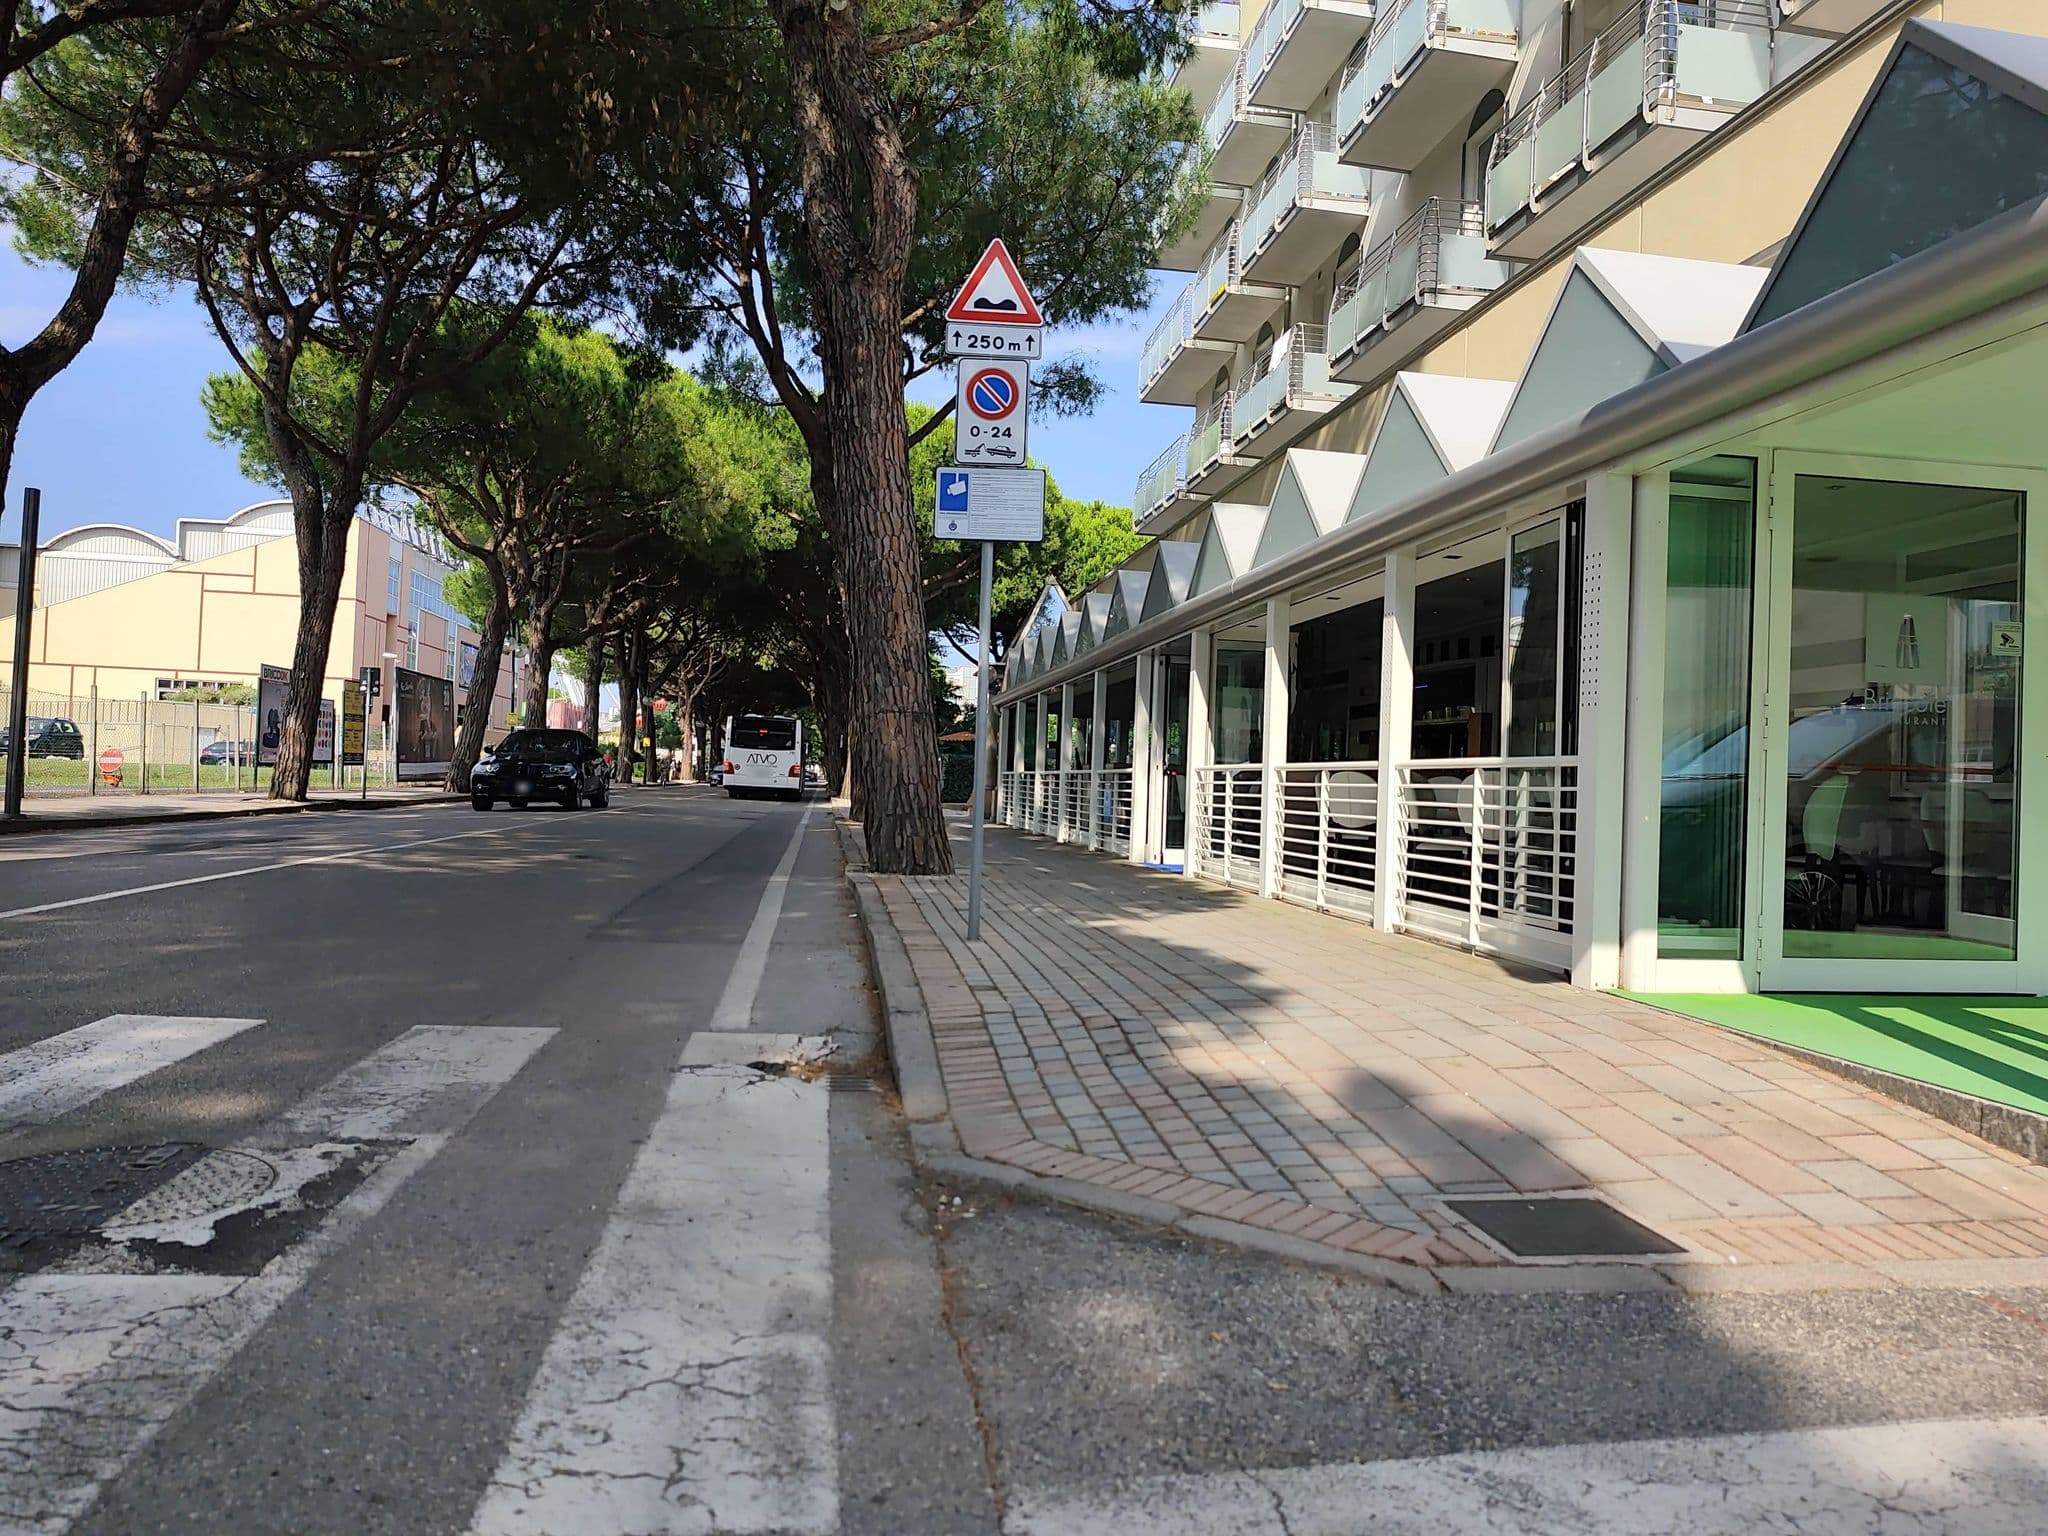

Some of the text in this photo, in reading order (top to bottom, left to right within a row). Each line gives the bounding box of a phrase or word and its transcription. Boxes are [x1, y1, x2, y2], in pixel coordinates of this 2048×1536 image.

[967, 334, 1021, 352] 250 m
[746, 753, 778, 765] ATVO
